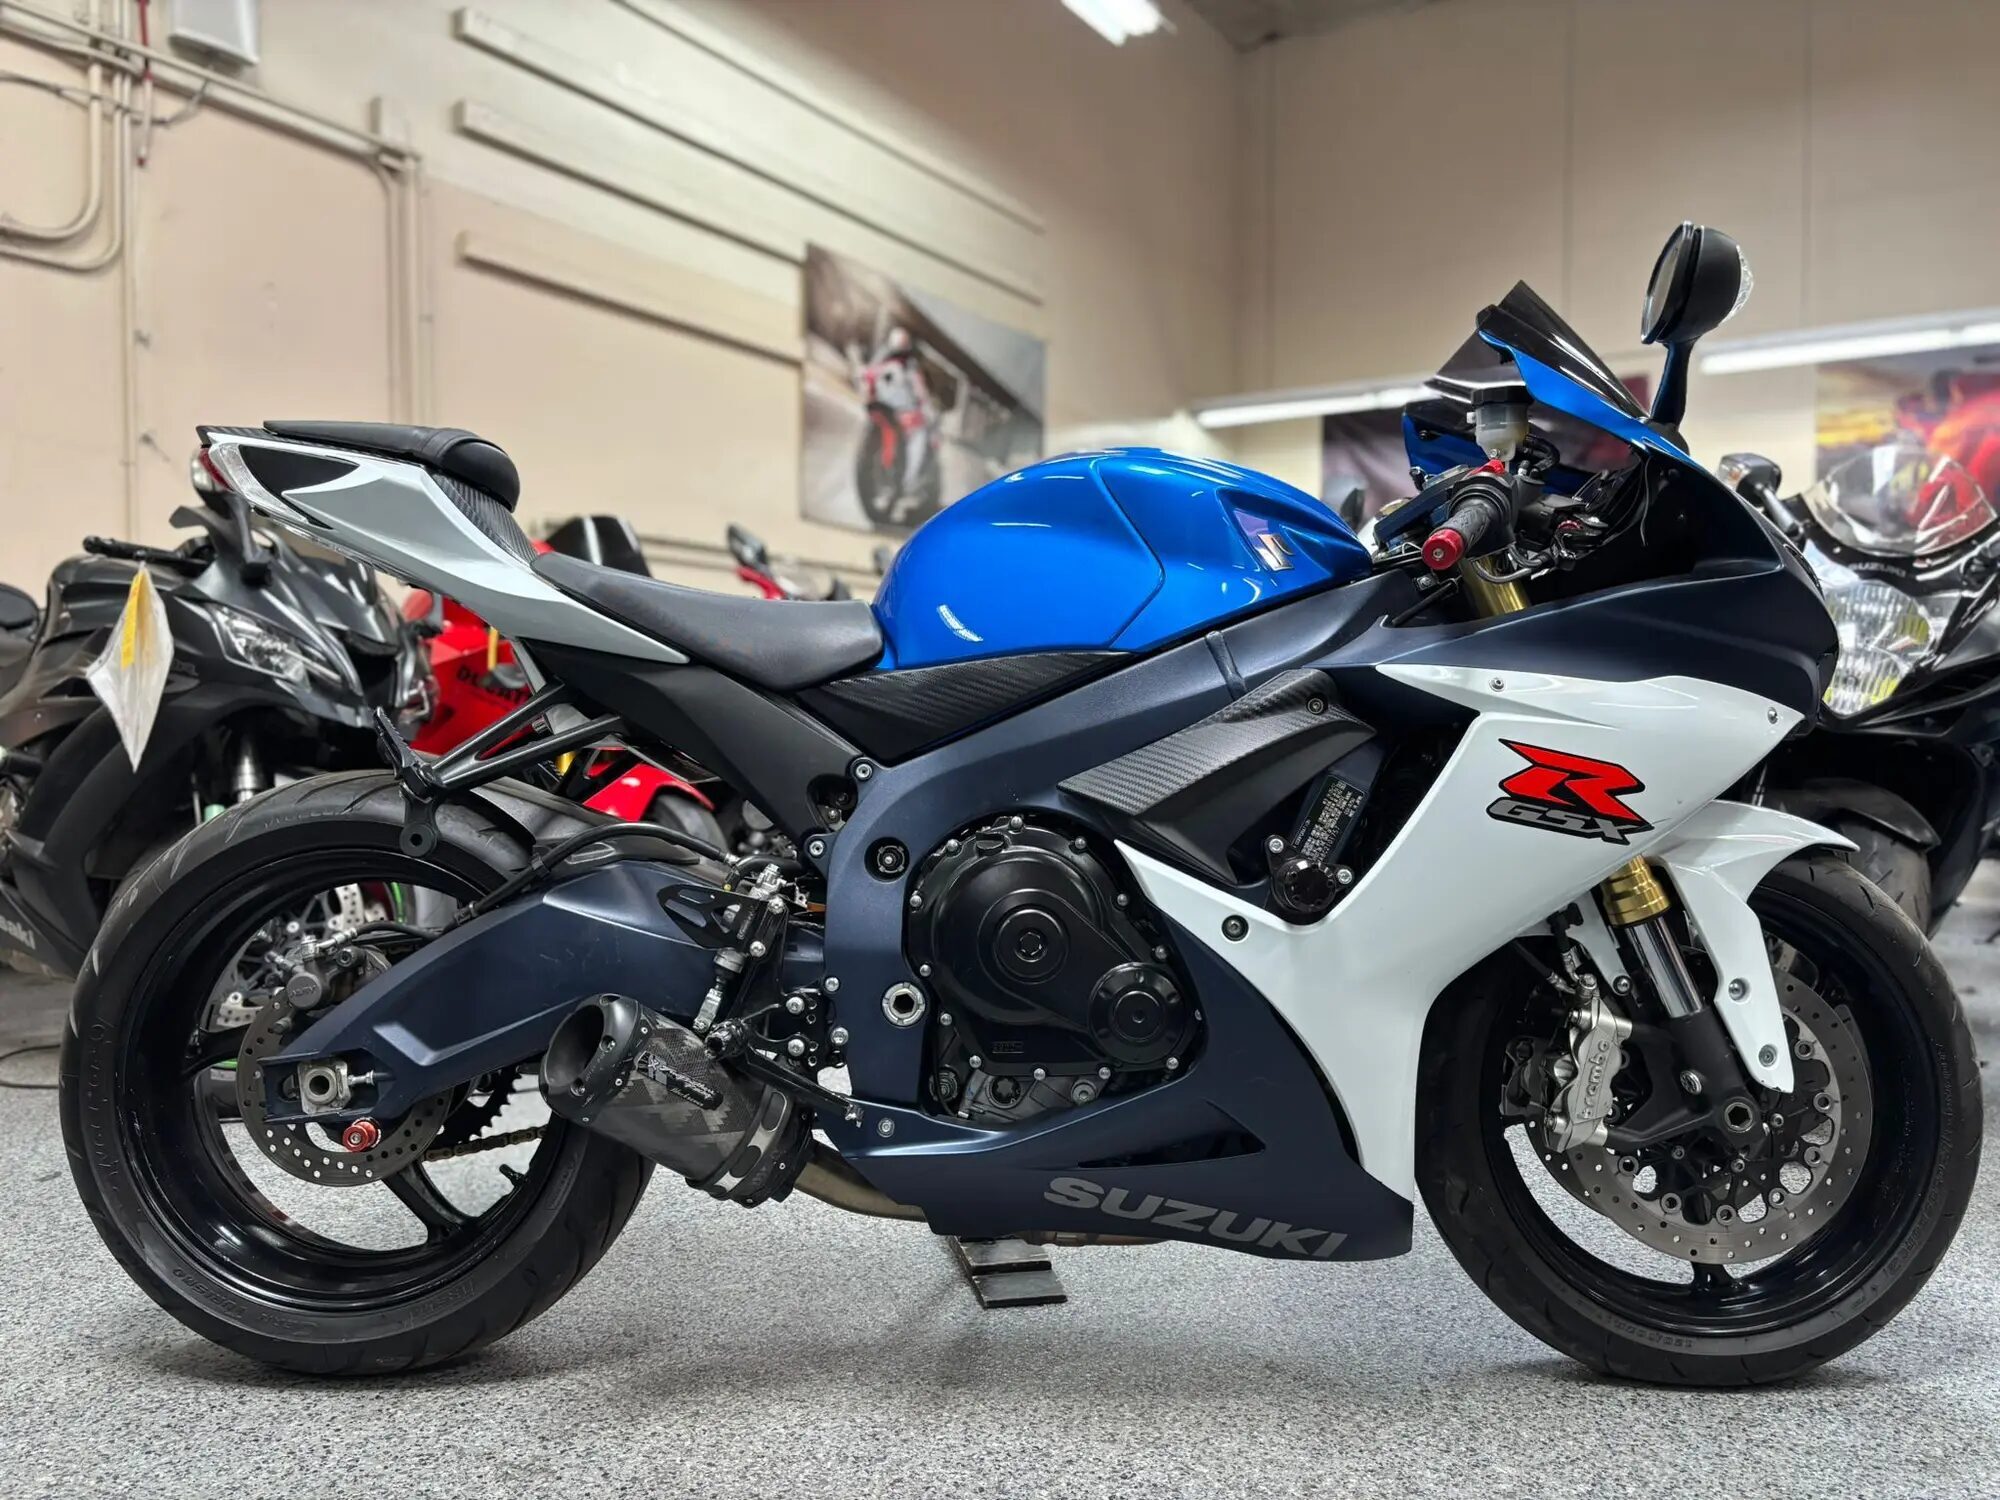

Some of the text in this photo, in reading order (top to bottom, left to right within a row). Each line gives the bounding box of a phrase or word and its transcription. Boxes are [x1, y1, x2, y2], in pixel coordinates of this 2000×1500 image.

[1487, 797, 1639, 845] GSX
[1582, 1040, 1610, 1119] brembo
[1044, 1177, 1348, 1258] SUZUKI
